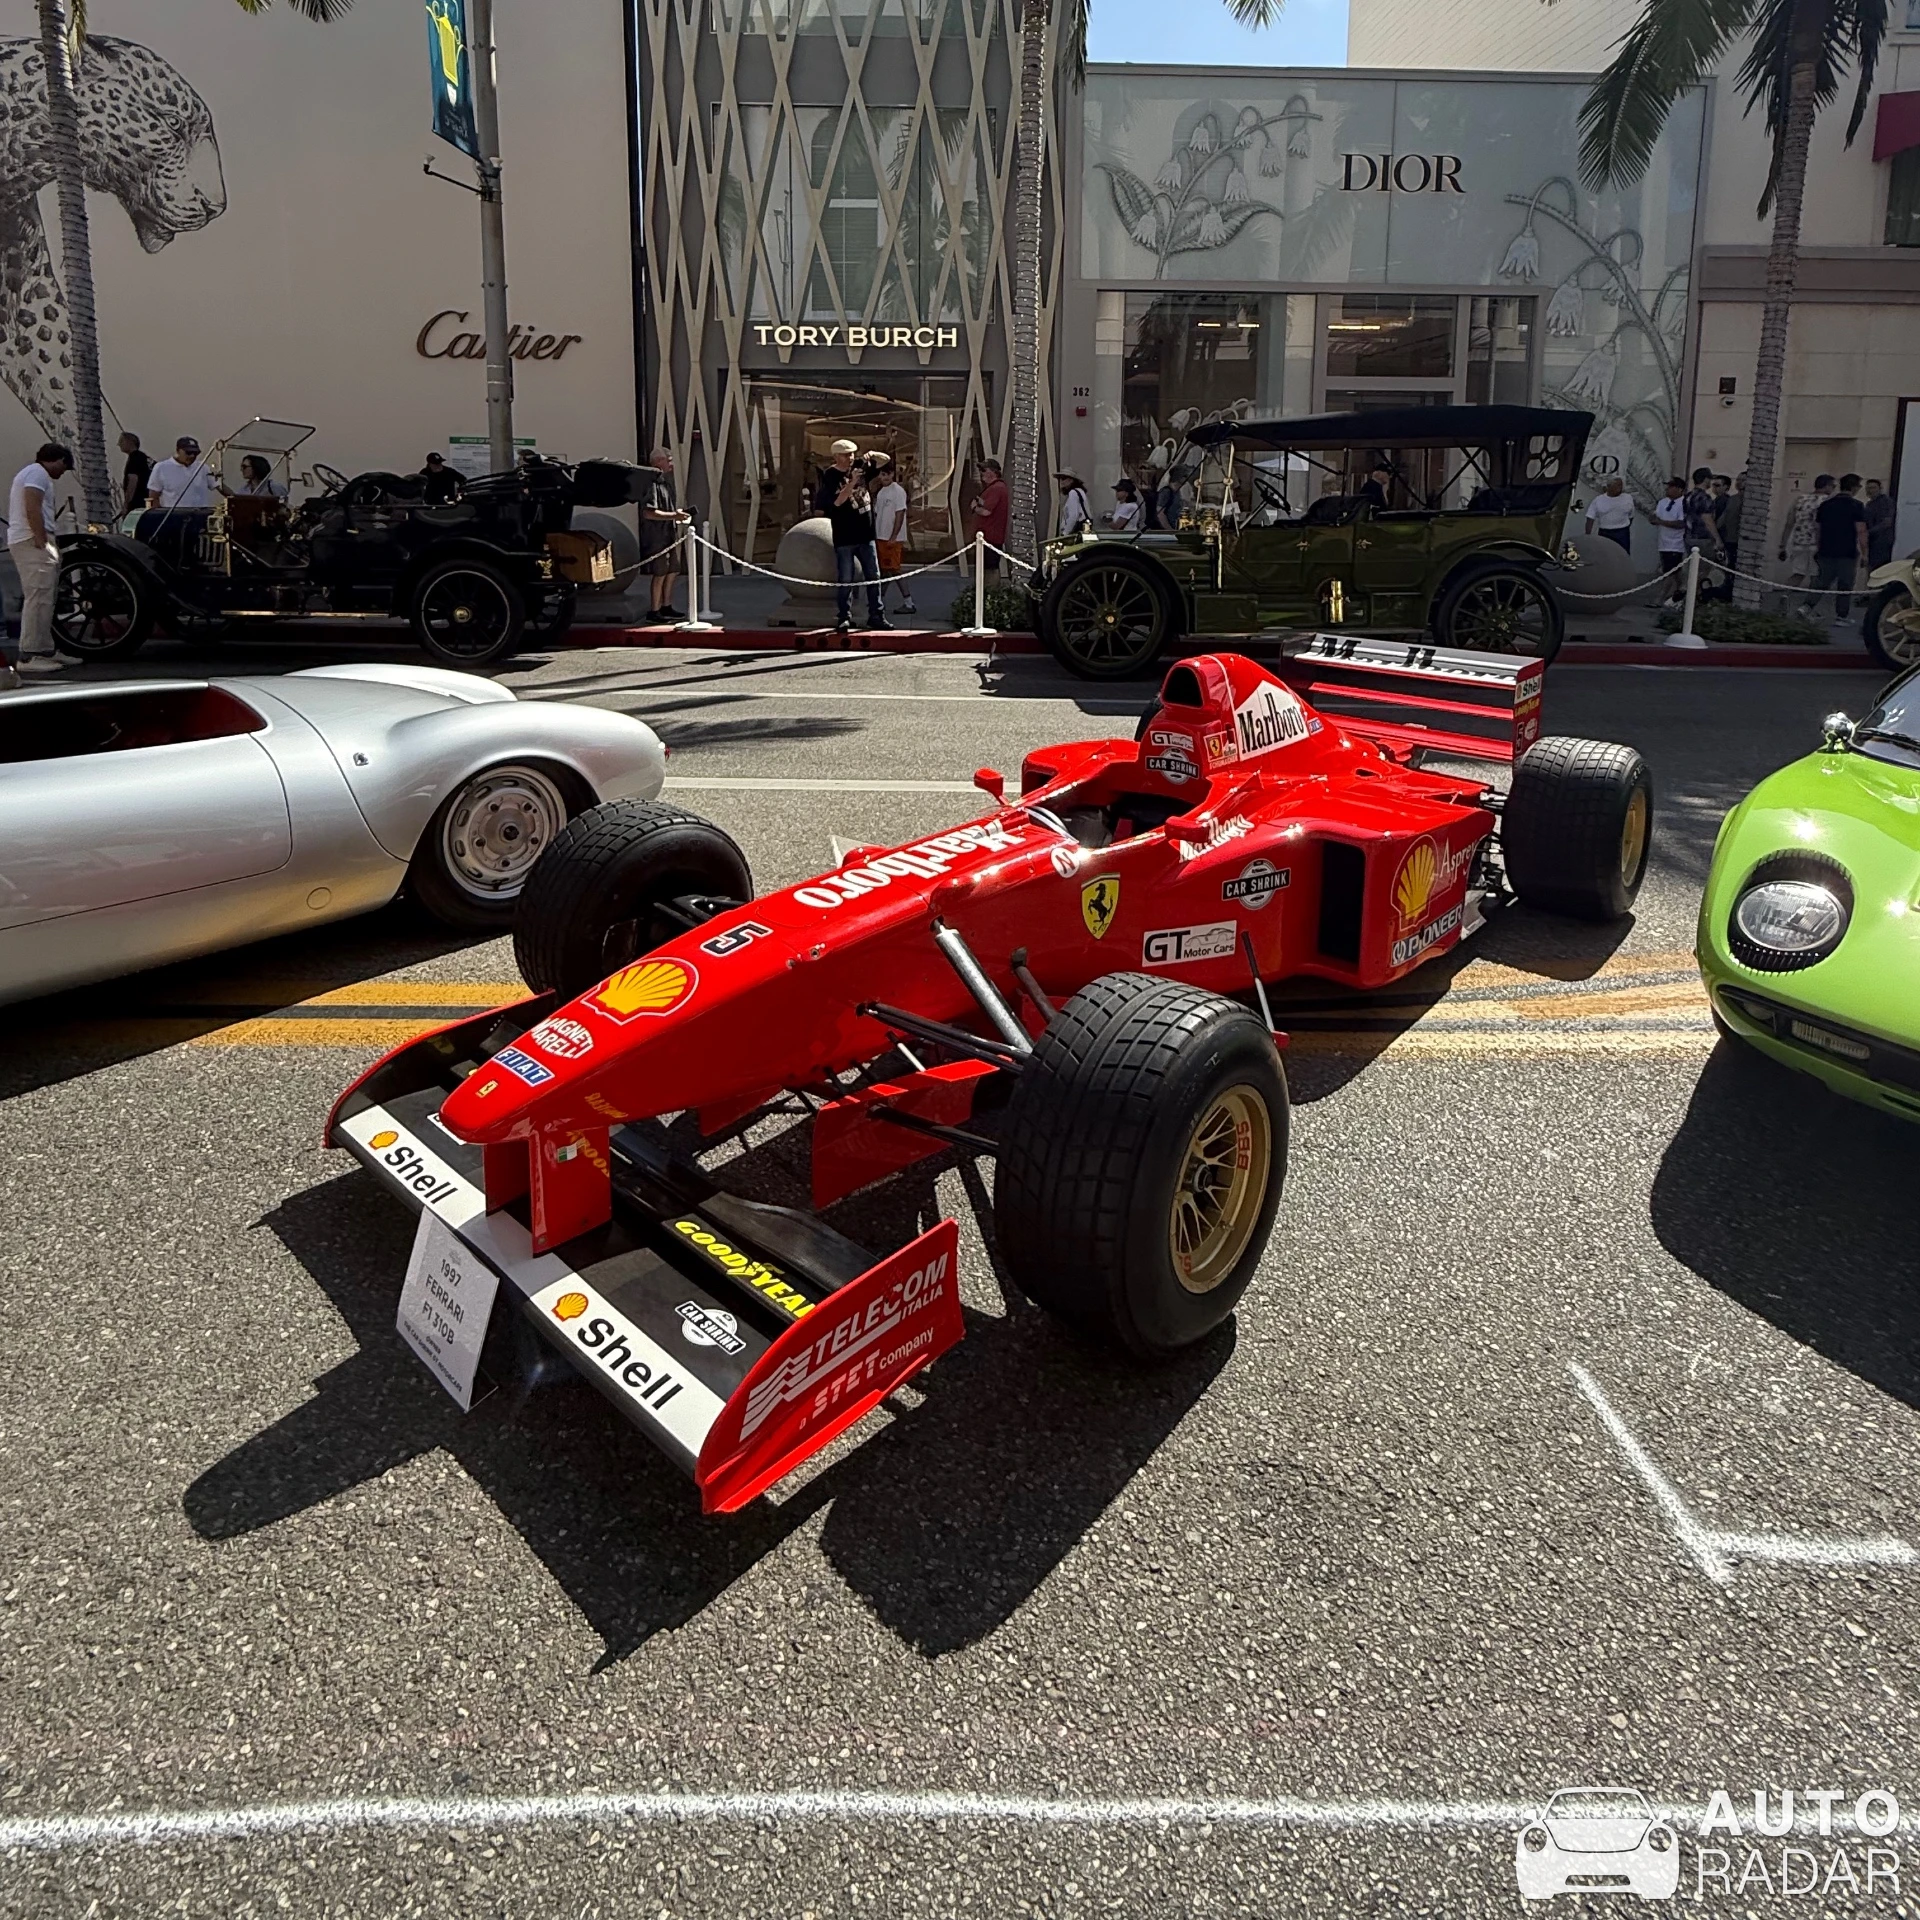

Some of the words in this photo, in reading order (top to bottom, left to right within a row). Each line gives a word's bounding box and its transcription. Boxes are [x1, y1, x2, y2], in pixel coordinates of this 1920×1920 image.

[1339, 153, 1466, 193] DIOR
[416, 310, 582, 360] Catier
[753, 325, 840, 347] TORY
[848, 327, 958, 348] BURCH
[1073, 387, 1090, 397] 362
[1152, 732, 1173, 745] GT
[1237, 692, 1305, 754] Marlboro
[1149, 758, 1167, 769] CAR
[1170, 760, 1197, 776] SHRINK
[793, 819, 1025, 908] Marlboro
[1226, 882, 1246, 897] CAR
[1250, 873, 1287, 892] SHRINK
[701, 921, 772, 956] 5
[1144, 930, 1190, 963] GT
[1183, 947, 1211, 959] Motor
[1213, 944, 1234, 954] Cars
[530, 1026, 592, 1059] MARELLI
[534, 1017, 594, 1053] MAGNETI
[497, 1050, 548, 1081] FIAT
[1236, 1120, 1250, 1170] BBS
[384, 1146, 458, 1204] Shell
[441, 1259, 462, 1287] 1997
[425, 1274, 464, 1324] FERRARI
[815, 1252, 949, 1366] TELECOM
[901, 1285, 944, 1320] ITALIA
[411, 1330, 419, 1342] CAR
[422, 1301, 433, 1321] F1
[432, 1311, 455, 1345] 310B
[681, 1304, 705, 1326] CAR
[700, 1321, 740, 1351] SHRINK
[425, 1335, 442, 1354] OWNER
[577, 1317, 684, 1411] Shell
[812, 1349, 881, 1419] STET
[879, 1327, 934, 1370] company
